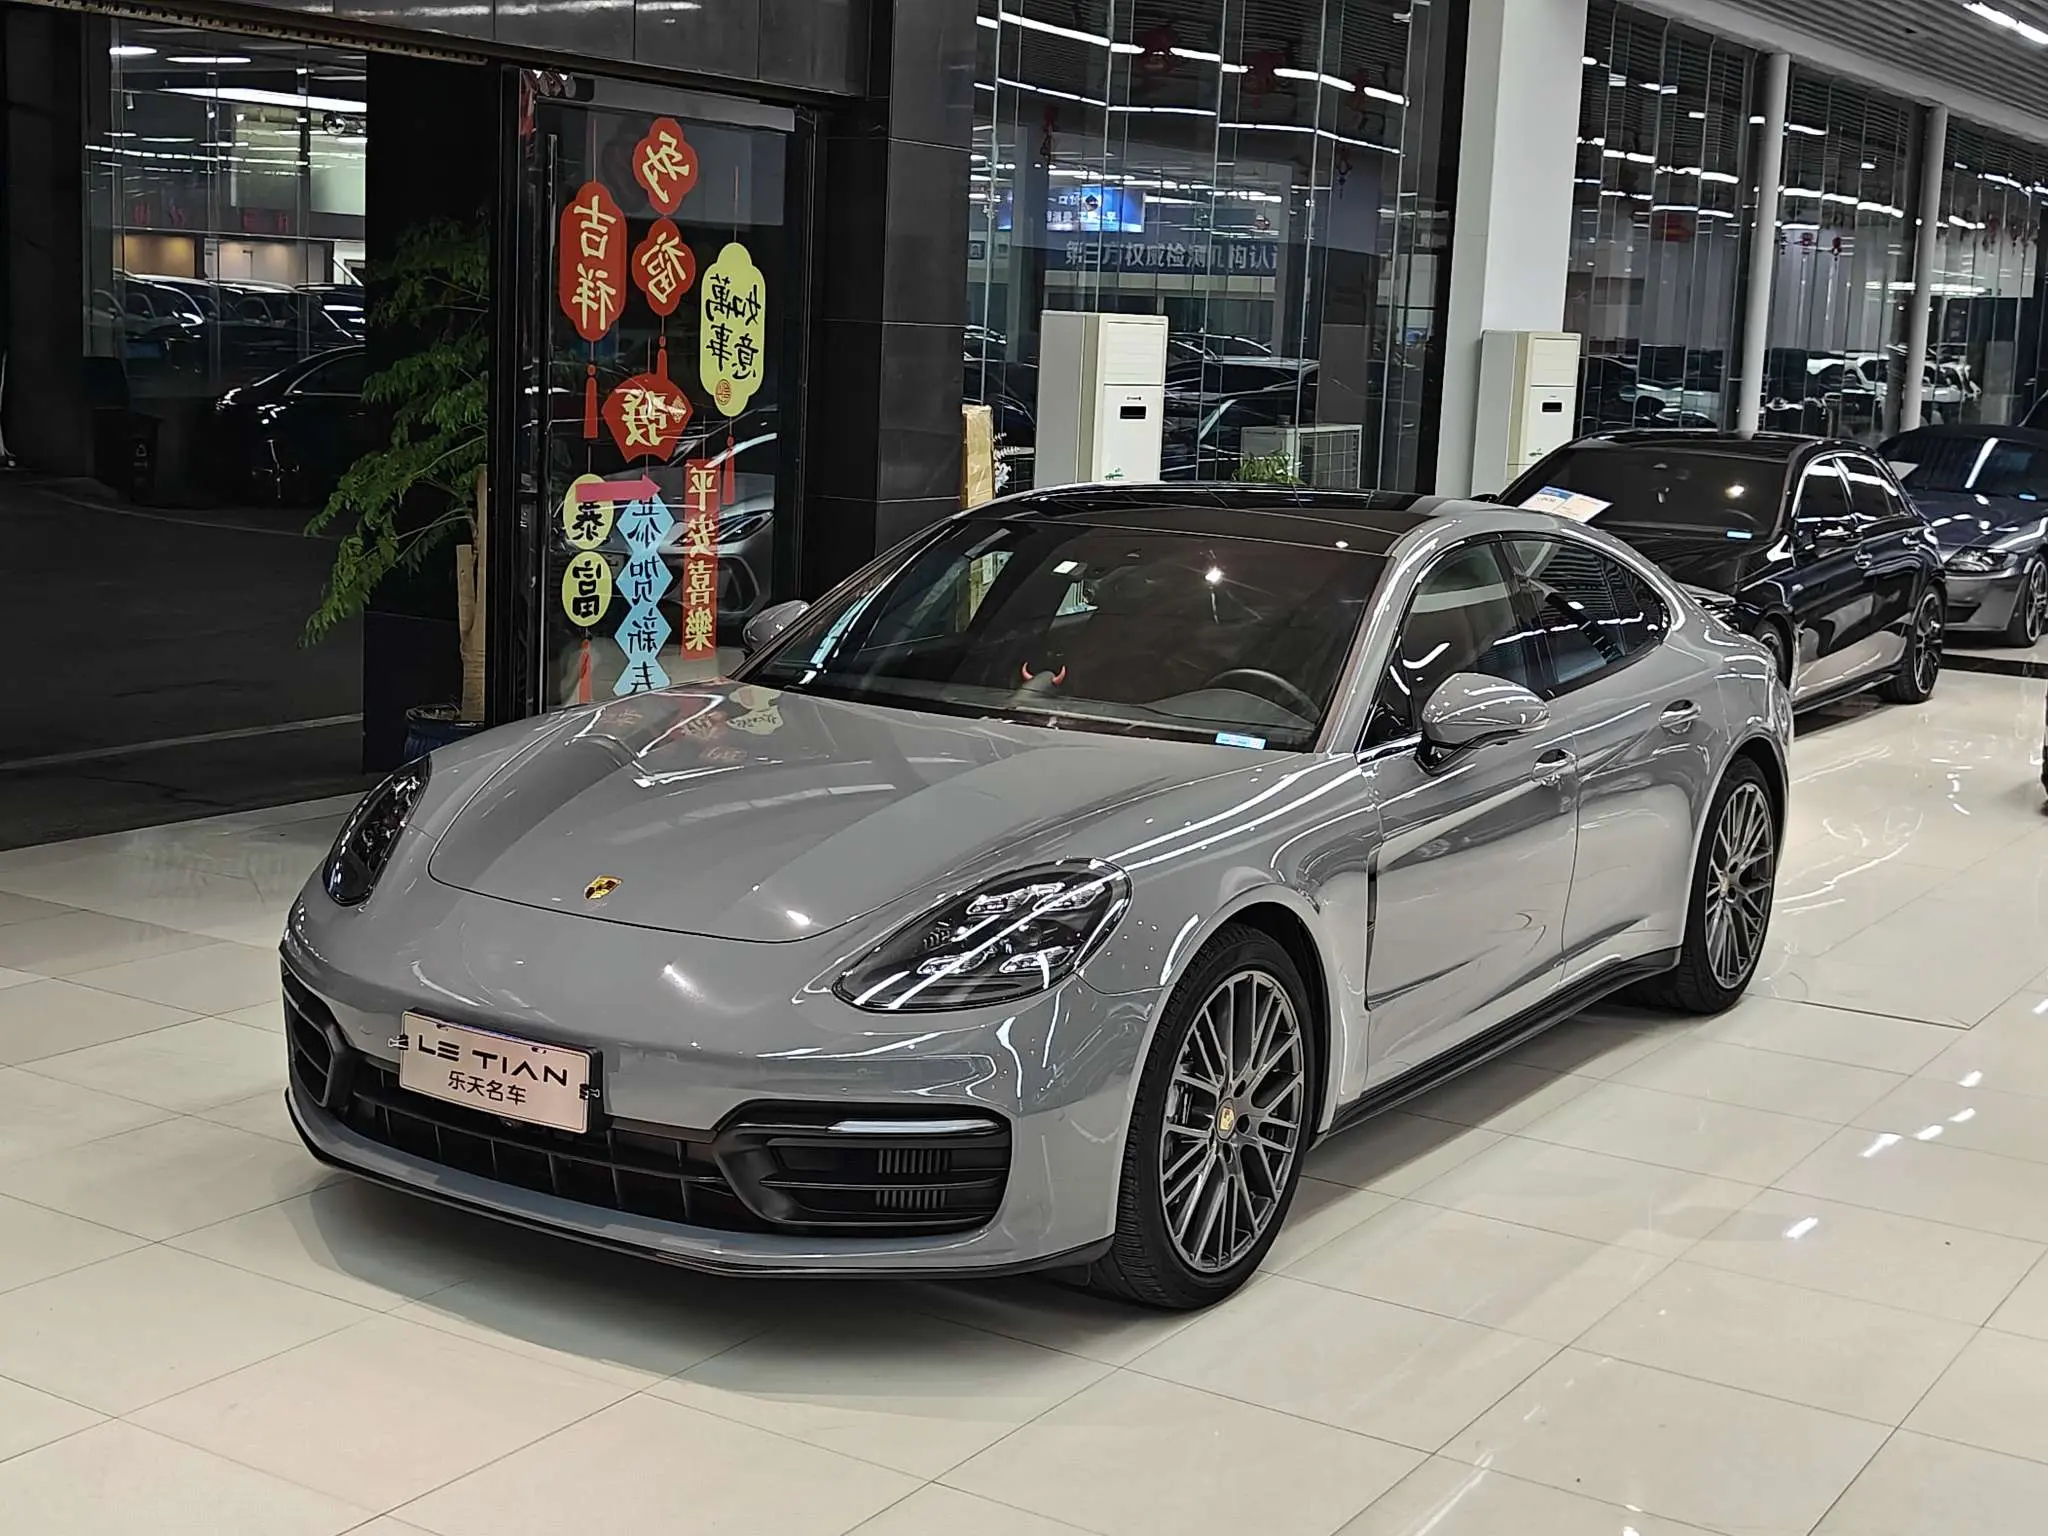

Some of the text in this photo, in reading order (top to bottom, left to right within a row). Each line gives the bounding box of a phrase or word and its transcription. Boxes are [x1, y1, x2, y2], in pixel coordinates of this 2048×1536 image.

[418, 1034, 568, 1087] LE TIAN
[448, 1070, 527, 1106] 乐天名车
